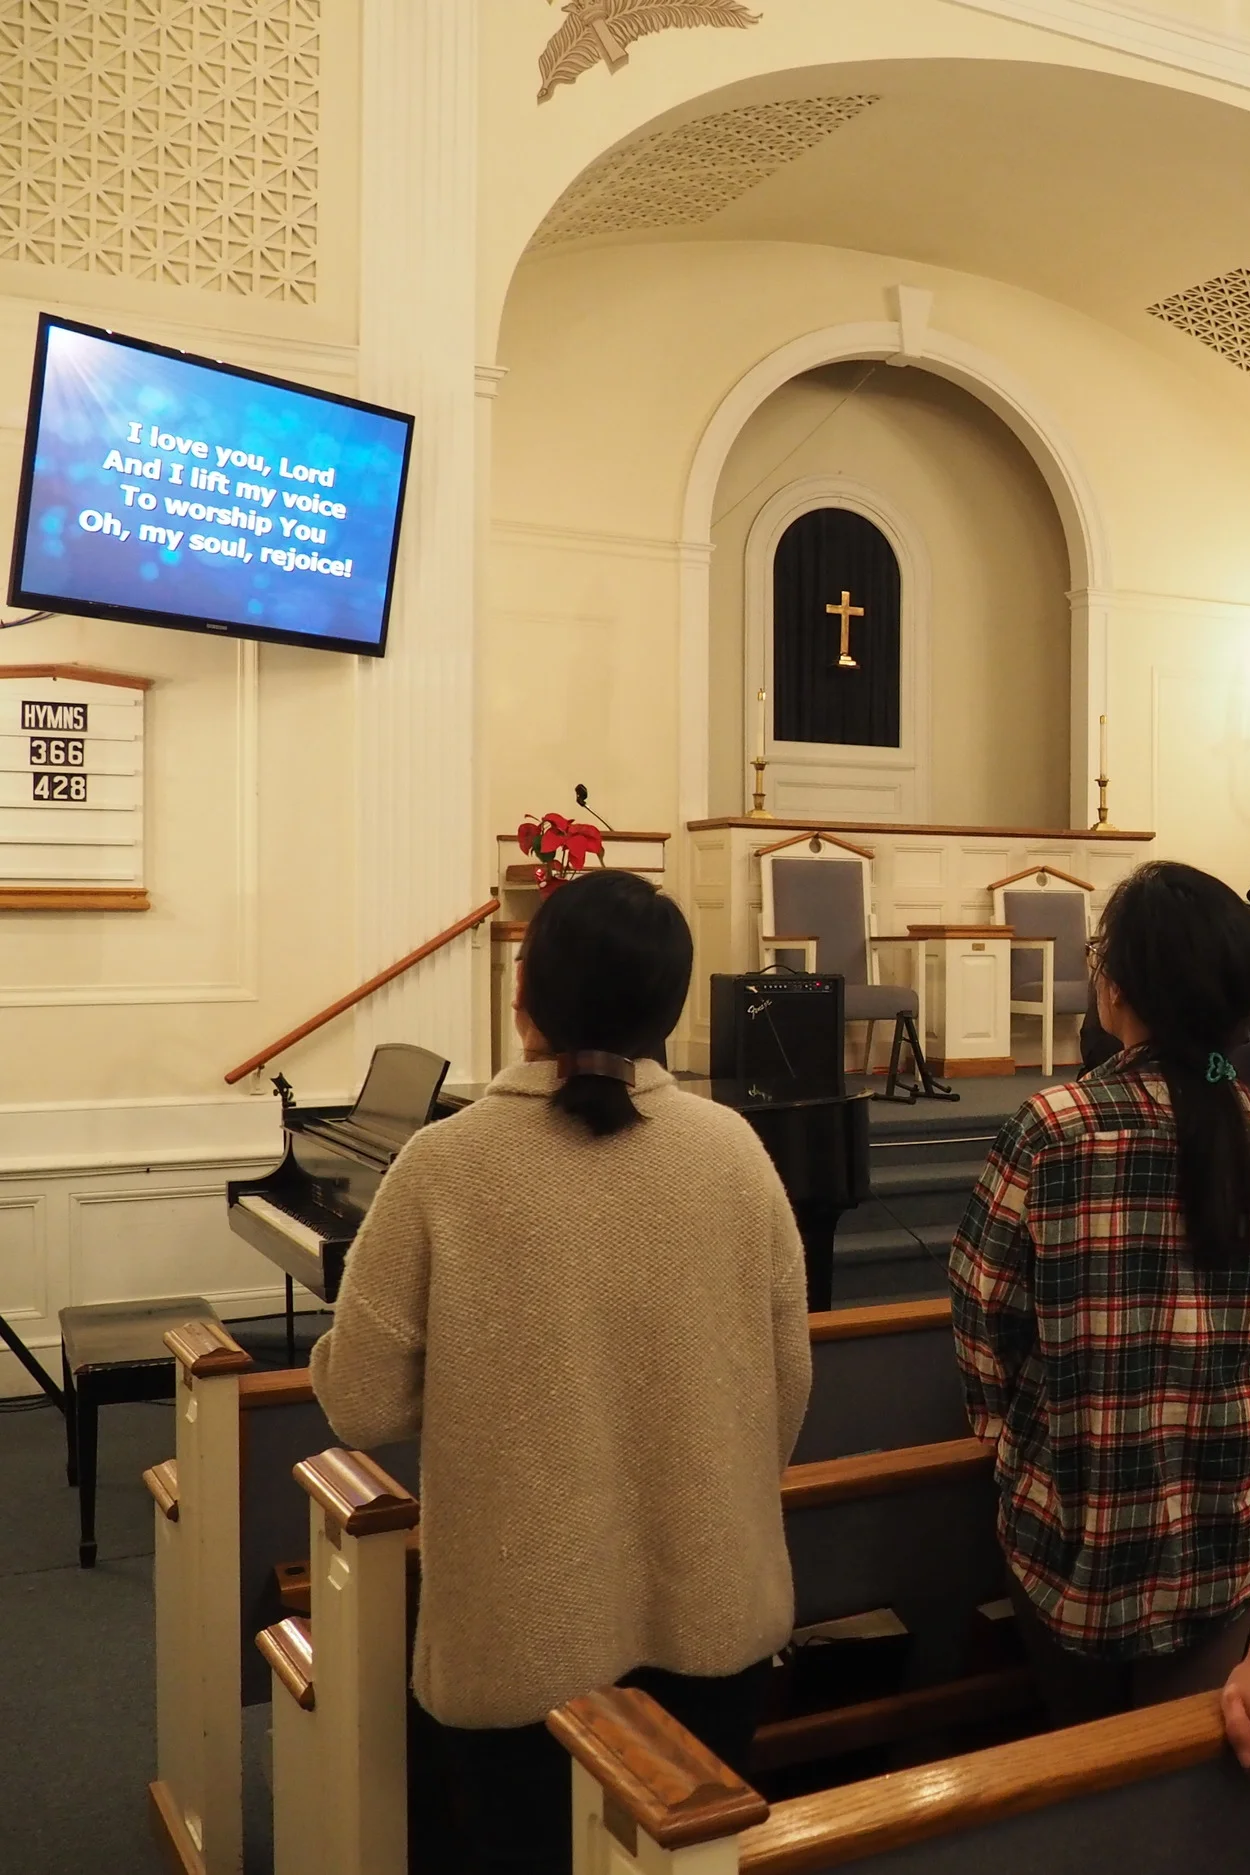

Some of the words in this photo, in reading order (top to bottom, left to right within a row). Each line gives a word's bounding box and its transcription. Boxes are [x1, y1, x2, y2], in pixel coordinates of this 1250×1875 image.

[102, 449, 162, 480] And
[168, 462, 184, 485] I
[190, 466, 230, 495] lift
[235, 481, 277, 508] my
[282, 493, 347, 520] voice
[126, 421, 143, 444] I
[149, 425, 209, 459] love
[215, 445, 271, 477] you,
[279, 457, 336, 488] Lord
[79, 509, 131, 542] Oh,
[138, 523, 184, 551] my
[188, 537, 253, 564] soul,
[260, 546, 353, 578] rejoice!
[120, 483, 158, 511] To
[164, 497, 273, 537] worship
[279, 516, 327, 545] You
[24, 704, 85, 730] HYMNS
[31, 739, 84, 765] 366
[34, 775, 86, 800] 428
